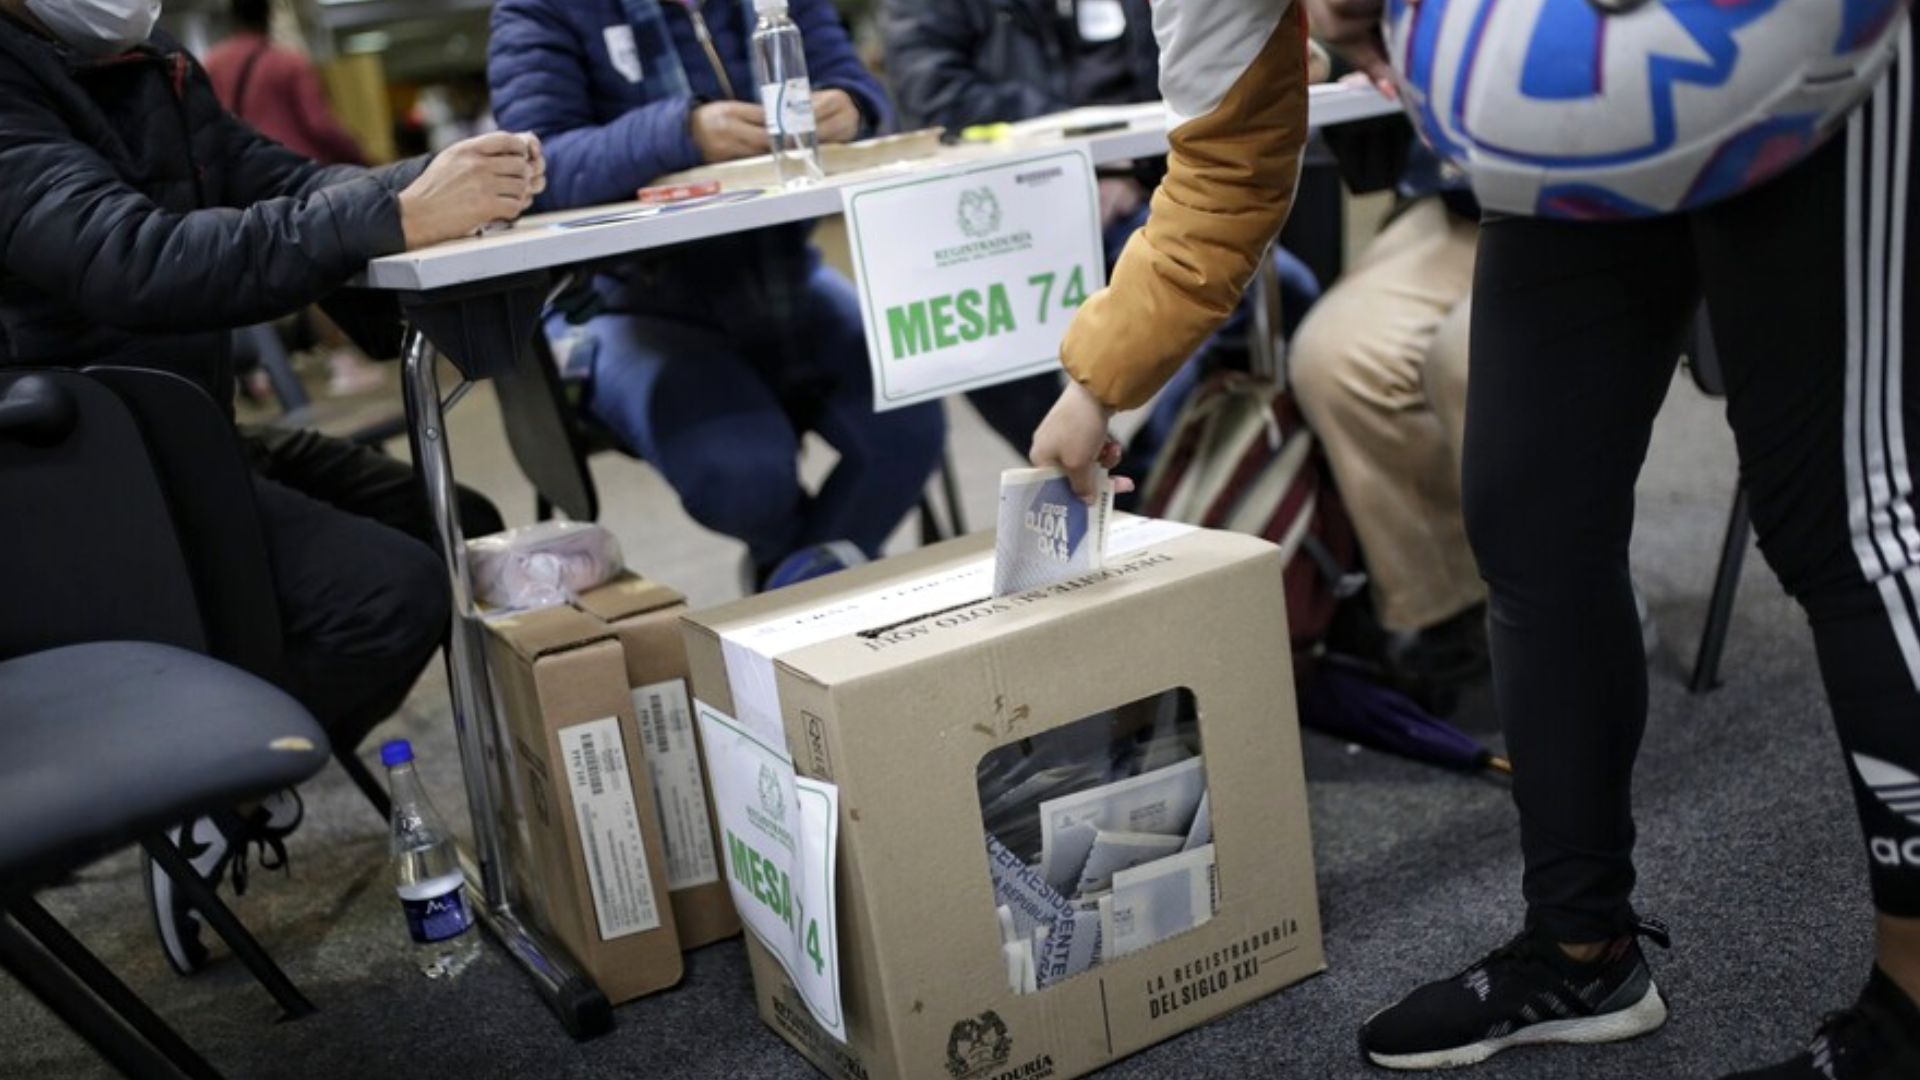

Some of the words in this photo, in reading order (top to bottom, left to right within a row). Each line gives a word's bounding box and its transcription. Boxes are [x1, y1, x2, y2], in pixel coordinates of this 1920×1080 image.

[886, 282, 1016, 360] MESA
[1028, 264, 1088, 324] 74
[936, 601, 1016, 630] VOTO
[726, 829, 795, 934] MESA
[1146, 975, 1165, 995] LA
[1173, 918, 1298, 984] REGISTRADURÍA
[1150, 990, 1181, 1019] DEL
[1180, 969, 1228, 1006] SIGLO
[1232, 955, 1260, 984] XXI
